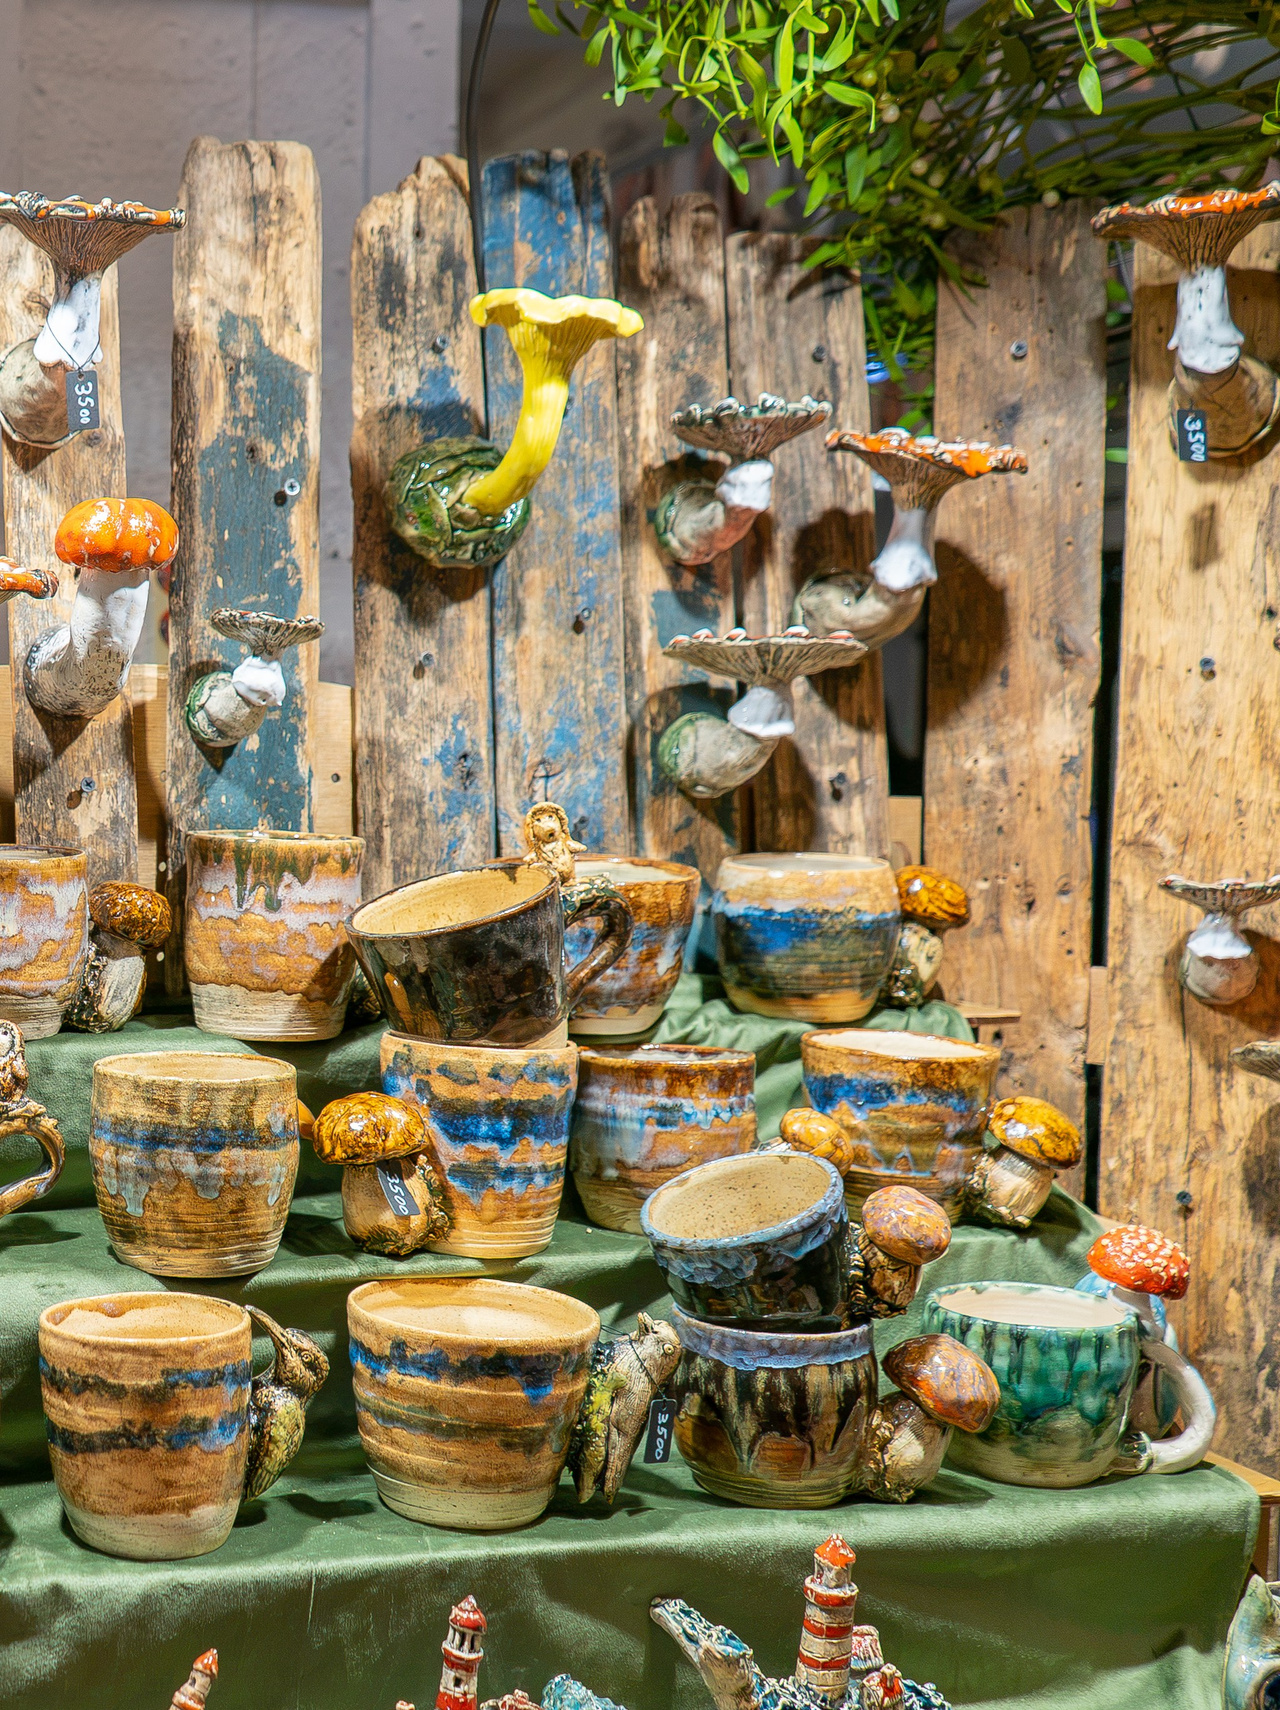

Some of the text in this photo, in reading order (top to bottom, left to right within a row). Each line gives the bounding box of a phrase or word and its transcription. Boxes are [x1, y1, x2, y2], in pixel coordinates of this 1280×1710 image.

[75, 381, 95, 424] 3500
[1184, 415, 1206, 462] 3500
[386, 1172, 409, 1216] 3500
[654, 1412, 669, 1461] 3500
